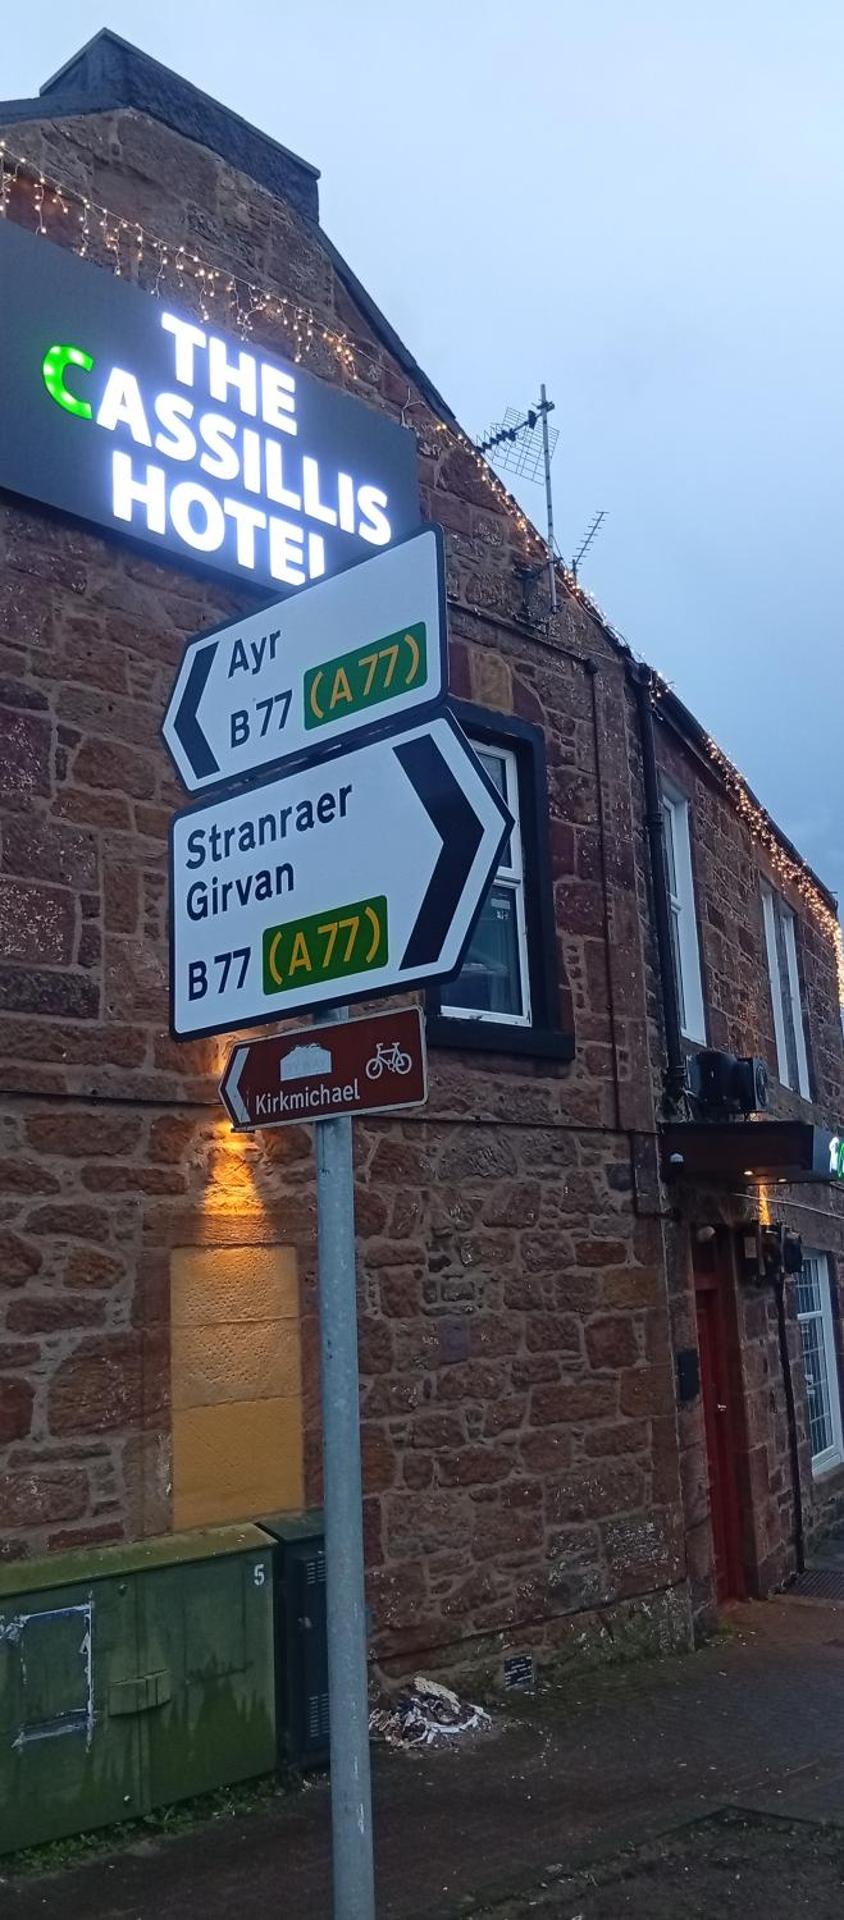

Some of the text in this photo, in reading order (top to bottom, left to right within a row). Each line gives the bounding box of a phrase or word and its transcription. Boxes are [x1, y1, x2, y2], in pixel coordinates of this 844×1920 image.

[161, 312, 298, 436] THE
[43, 344, 392, 546] CASSILLIS
[228, 630, 281, 678] Ayr
[185, 784, 353, 870] Stranraer
[186, 862, 295, 922] Girvan
[255, 1078, 361, 1115] Kirkmichael
[254, 1563, 265, 1586] 5
